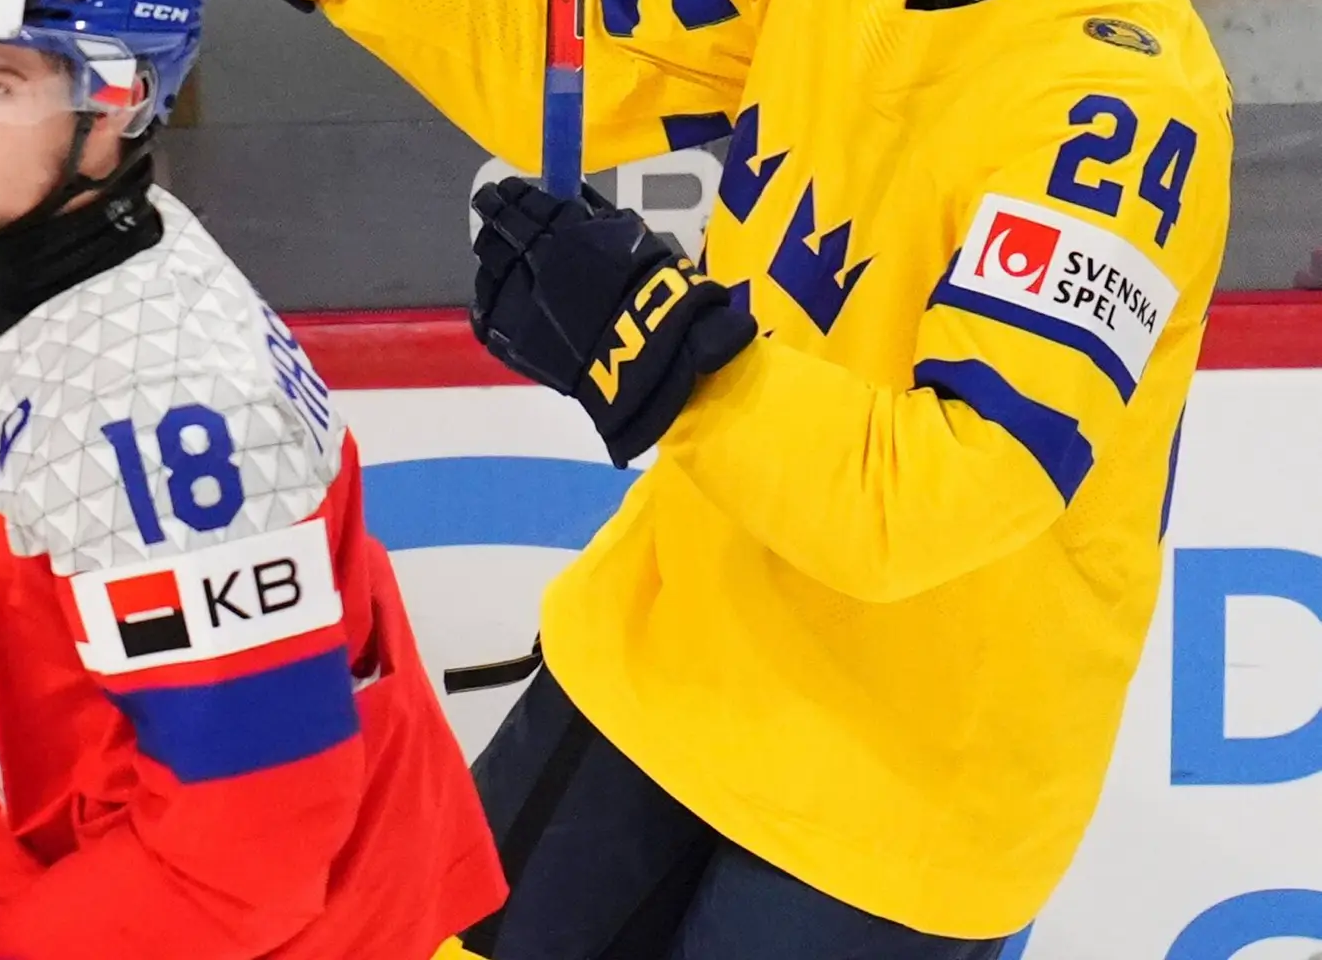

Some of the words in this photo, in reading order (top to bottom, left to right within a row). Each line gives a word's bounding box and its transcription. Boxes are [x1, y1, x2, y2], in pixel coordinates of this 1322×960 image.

[133, 1, 190, 24] CCM
[1046, 93, 1198, 250] 24
[1053, 279, 1116, 331] SPEL
[1063, 251, 1158, 334] SVENSKA
[100, 403, 245, 546] 18
[202, 557, 301, 629] KB
